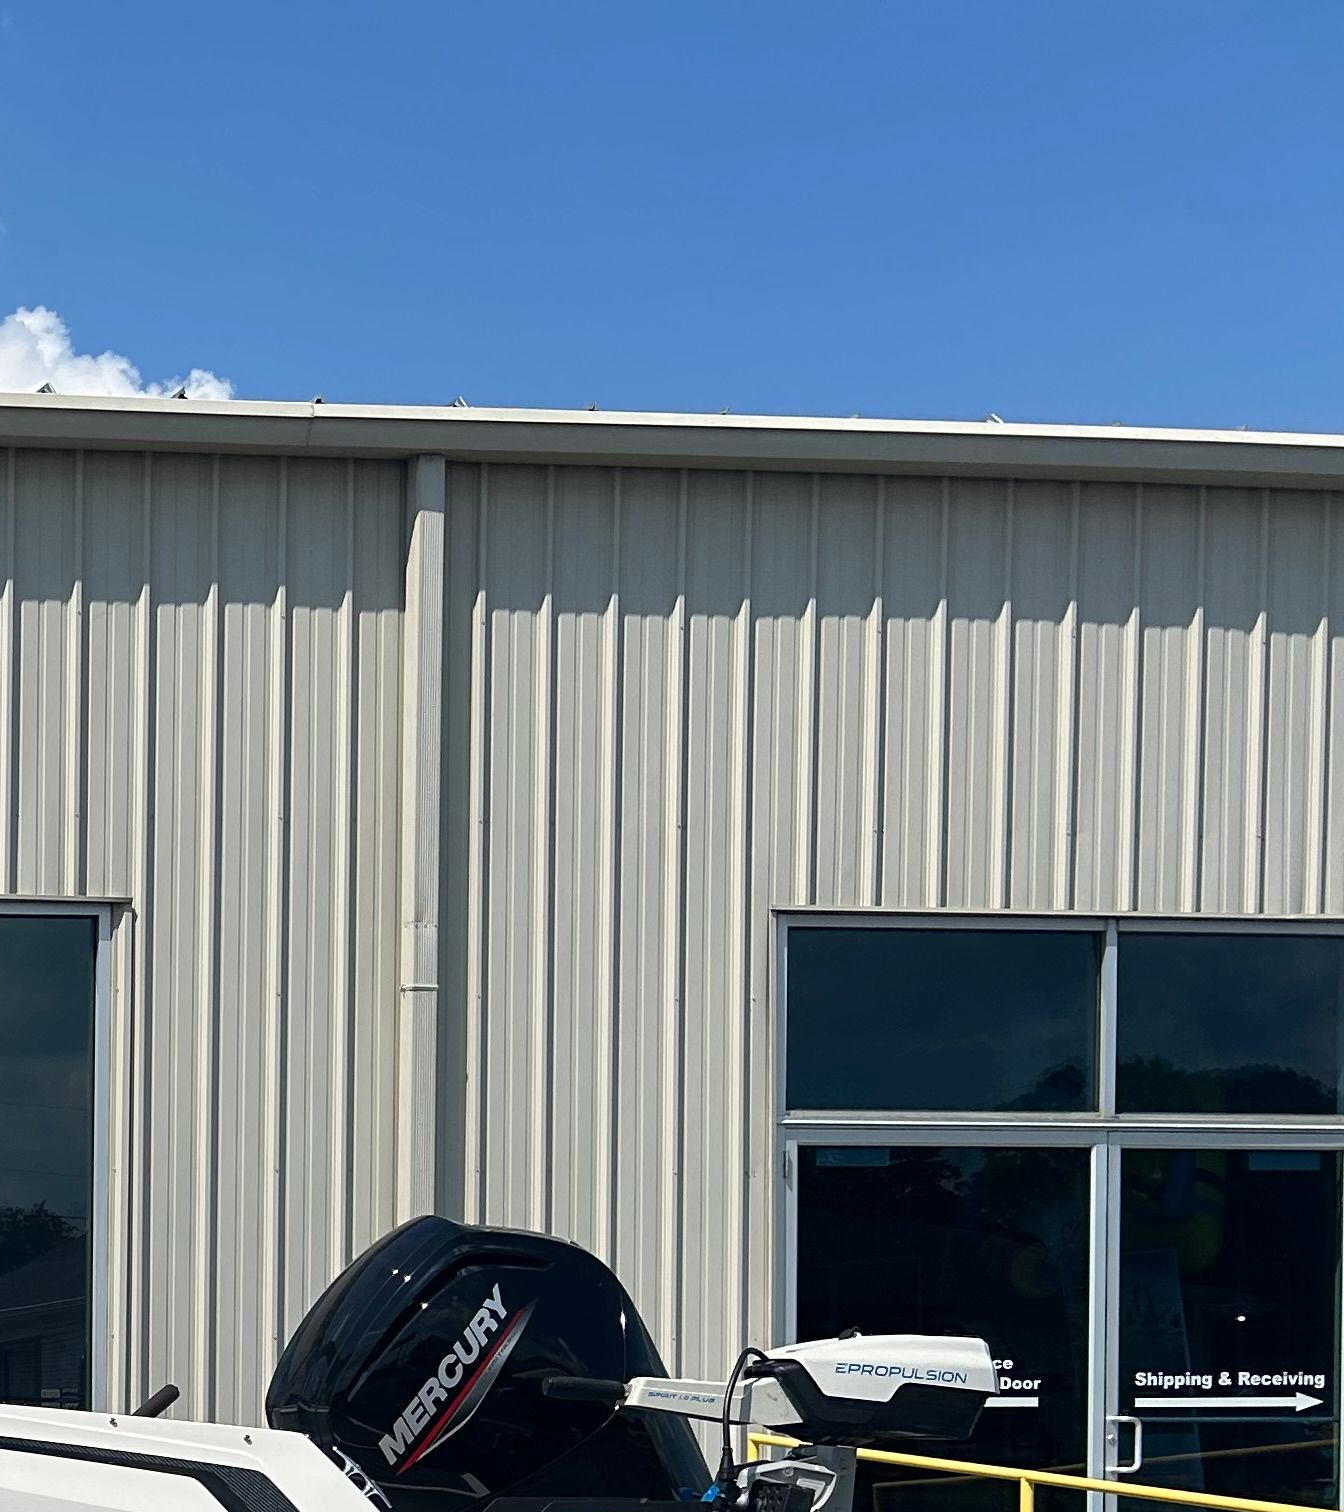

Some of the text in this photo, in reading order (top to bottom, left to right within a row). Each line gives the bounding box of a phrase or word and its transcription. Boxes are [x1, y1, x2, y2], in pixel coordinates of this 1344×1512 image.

[378, 1283, 508, 1466] MERCURY
[835, 1362, 968, 1384] EPROPULSION
[999, 1376, 1042, 1390] Door
[1134, 1371, 1325, 1390] Shipping & Receiving
